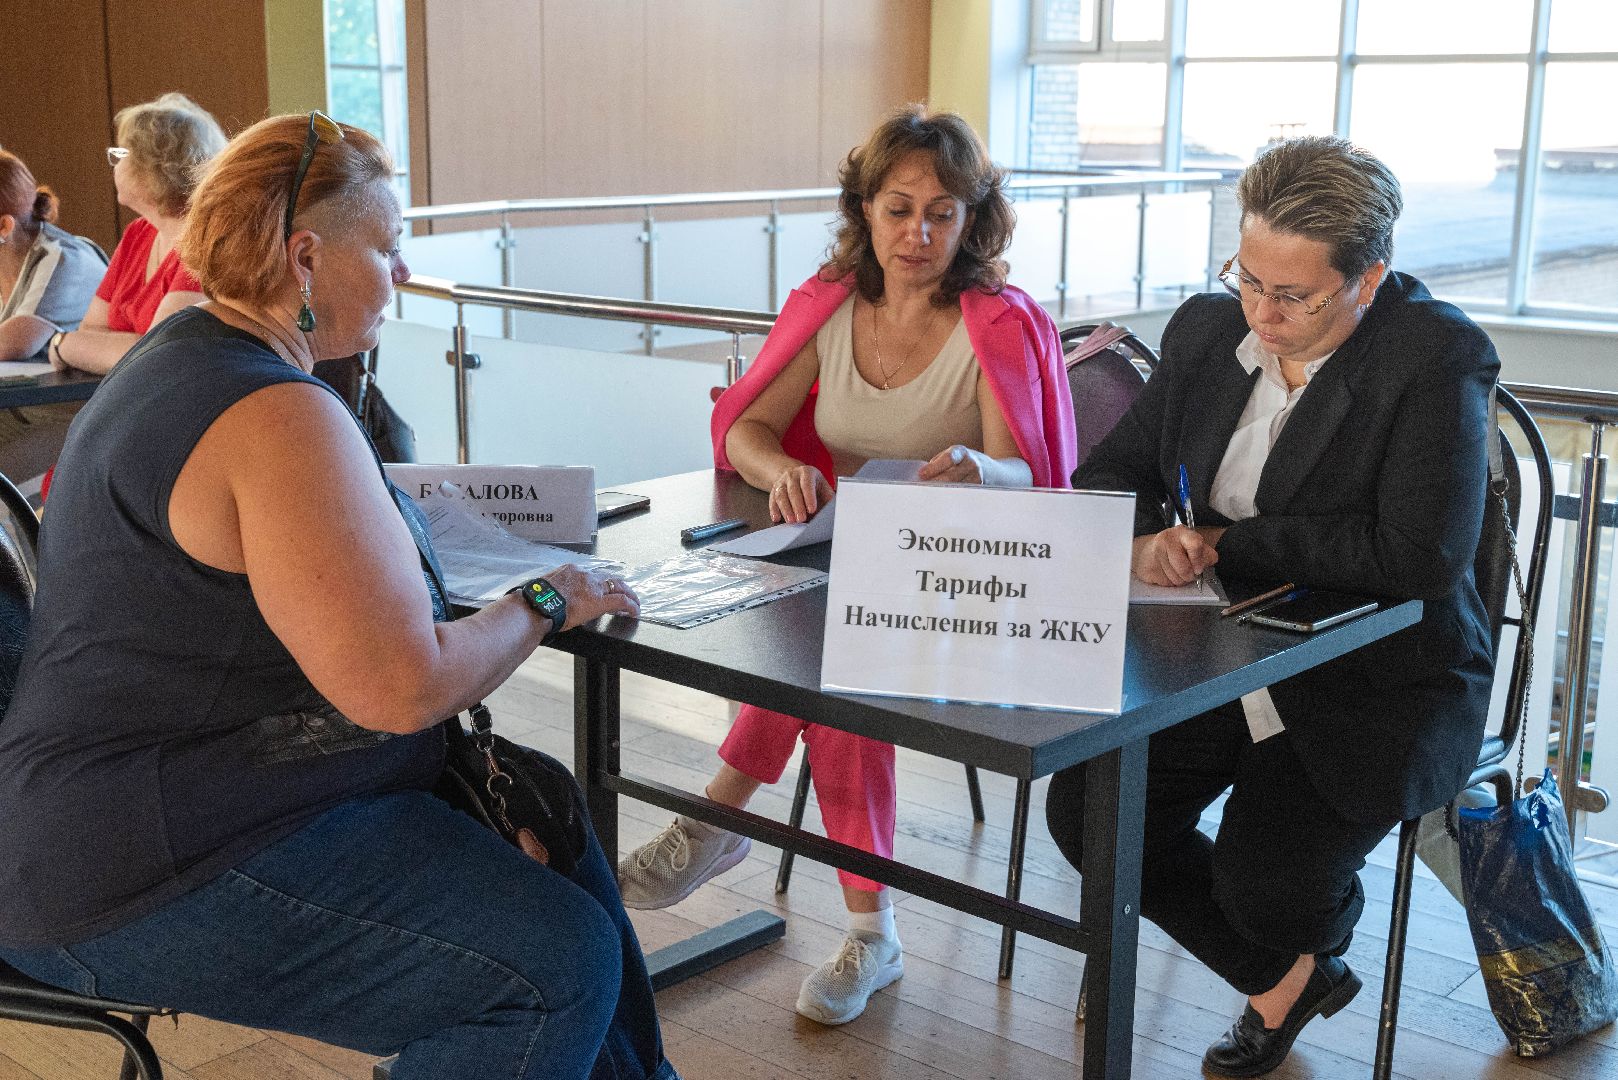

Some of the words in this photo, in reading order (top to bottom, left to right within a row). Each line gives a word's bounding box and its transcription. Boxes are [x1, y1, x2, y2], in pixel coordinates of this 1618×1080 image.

[419, 483, 540, 500] БАЛОВА
[481, 512, 553, 525] торовна
[898, 528, 1052, 559] Экономика
[916, 570, 1027, 602] Тарифы
[843, 605, 998, 636] Начисления
[1006, 622, 1032, 638] за
[1040, 619, 1112, 644] ЖКУ
